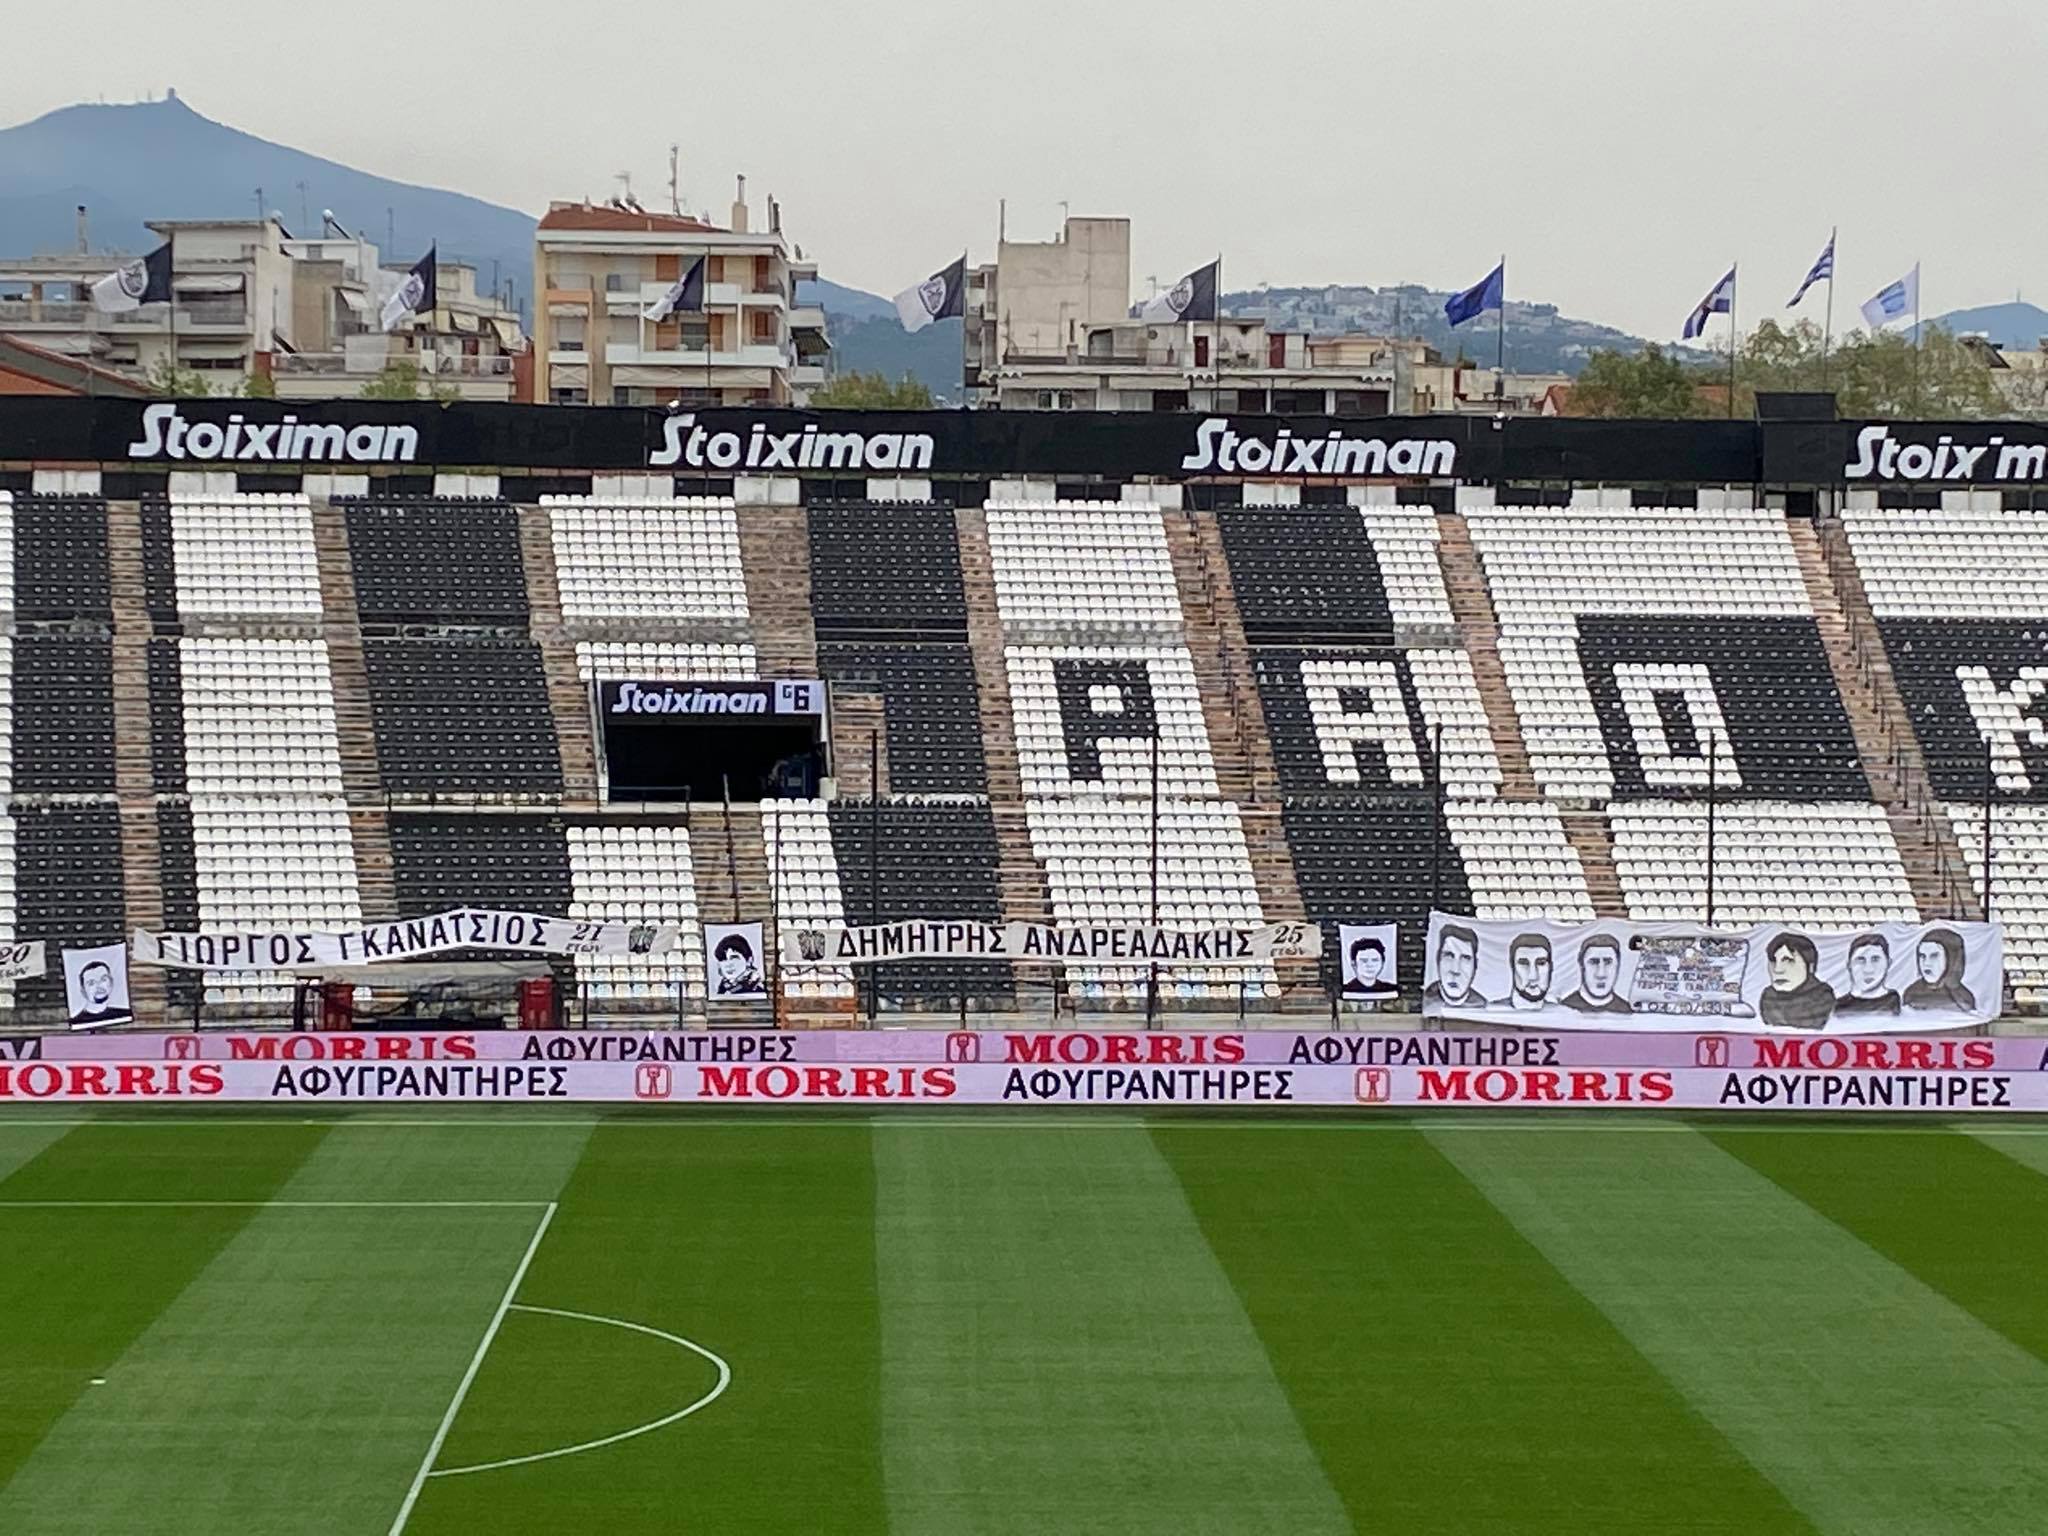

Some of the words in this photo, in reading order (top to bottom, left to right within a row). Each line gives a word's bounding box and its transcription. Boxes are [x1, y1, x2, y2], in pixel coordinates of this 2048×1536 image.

[129, 403, 417, 461] Stoiximan
[650, 413, 933, 469] Stoiximan
[1182, 418, 1455, 475] Stoiximan
[612, 683, 767, 713] Stoiximan
[156, 934, 316, 966] ΓΙΩΡΓΟΣ
[339, 912, 552, 959] ΓΚΑΝΑΤΣΙΟΣ
[570, 923, 604, 941] 21
[837, 923, 1006, 957] ΔΗΜΗΤΡΗΣ
[1023, 926, 1254, 958] ΑΝΔΡΕΑΔΑΚΗΣ
[1272, 925, 1306, 944] 25
[229, 1035, 476, 1059] MORRIS
[521, 1036, 797, 1060] ΑΦΥΓΡΑΝΤΗΡΕΣ
[1005, 1034, 1245, 1064] MORRIS
[1289, 1036, 1560, 1066] ΑΦΥΓΡΑΝΤΗΡΕΣ
[1753, 1039, 1995, 1069] MORRIS
[272, 1065, 568, 1096] ΑΦΥΓΡΑΝΤΗΡΕΣ
[699, 1065, 957, 1098] MORRIS
[1003, 1068, 1293, 1100] ΑΦΥΓΡΑΝΤΗΡΕΣ
[1418, 1070, 1674, 1103] MORRIS
[1720, 1075, 2011, 1107] ΑΦΥΓΡΑΝΤΗΡΕΣ
